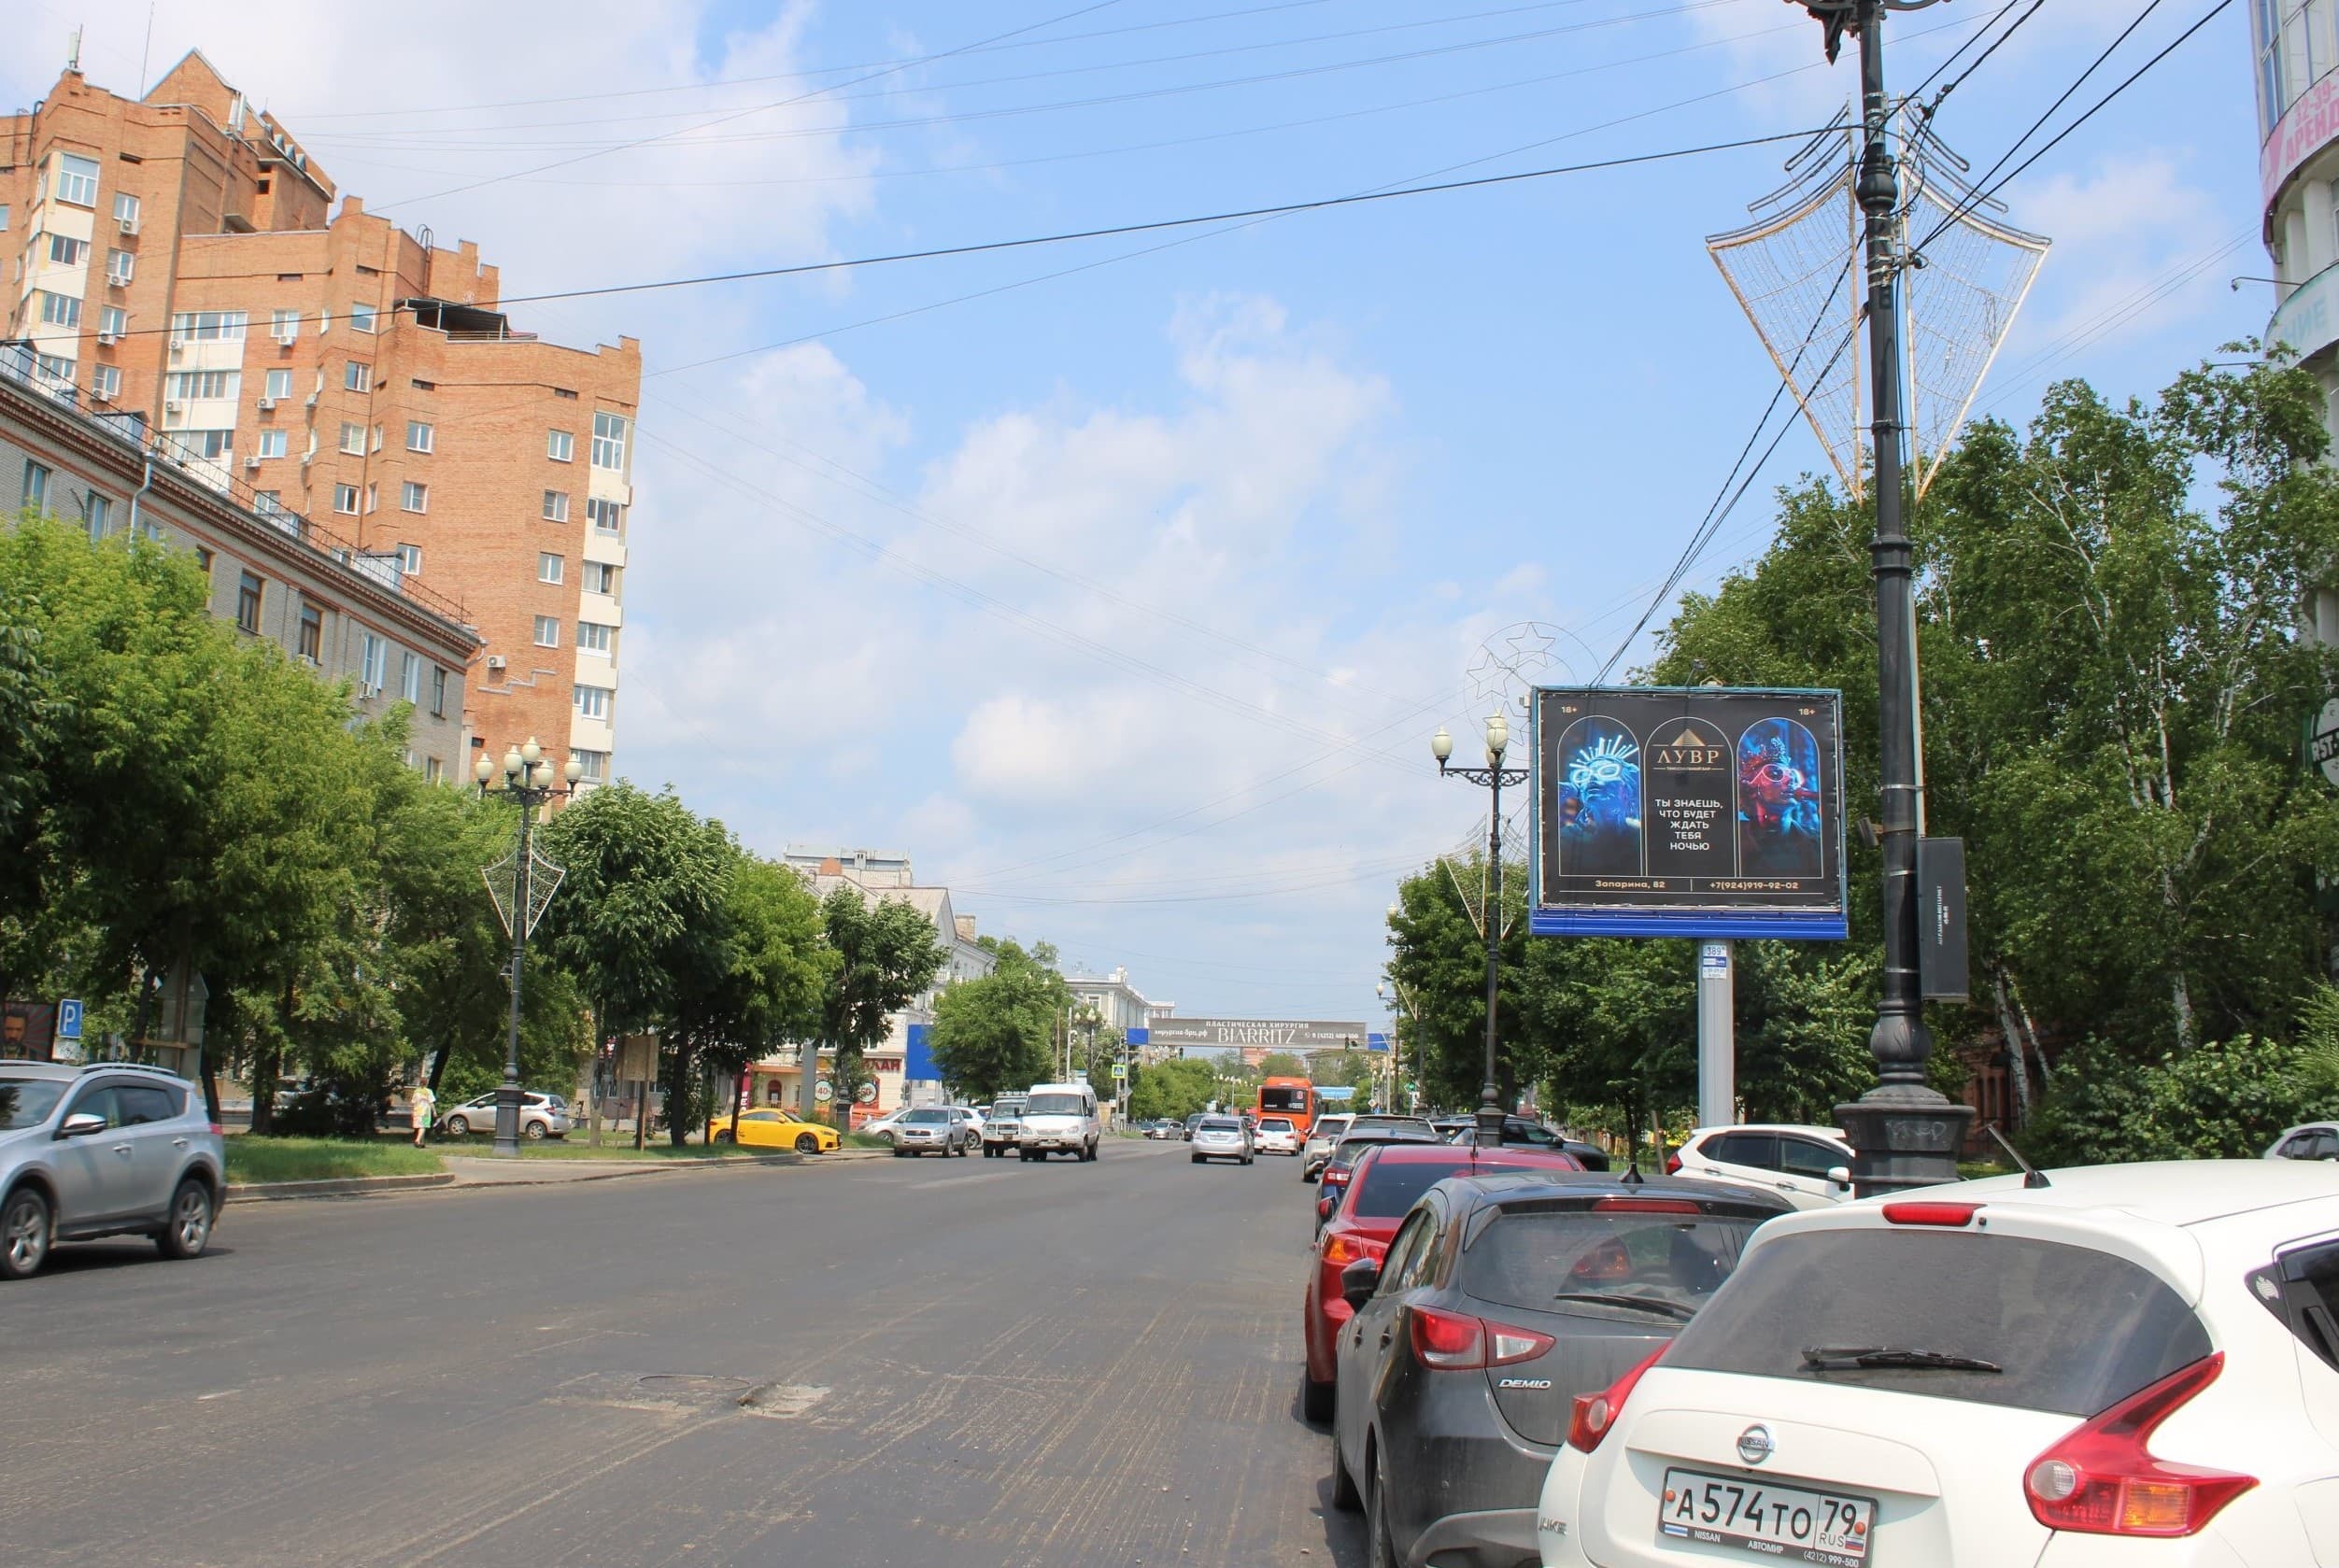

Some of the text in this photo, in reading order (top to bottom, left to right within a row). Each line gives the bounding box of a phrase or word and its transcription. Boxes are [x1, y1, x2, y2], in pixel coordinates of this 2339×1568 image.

[1657, 749, 1719, 764] ЛУВР
[1655, 798, 1723, 810] ТЫ ЗНАЕШЬ,
[1659, 810, 1716, 820] ЧТО БУДЕТ
[1670, 821, 1709, 829] ЖДАТЬ
[1675, 831, 1702, 840] ТЕБЯ
[1670, 841, 1710, 851] НОЧЬЮ
[1206, 1020, 1267, 1028] ПЛАСТИЧЕСКАЯ
[1218, 1027, 1296, 1044] BIARRITZ
[1499, 1378, 1552, 1389] DEMIO
[1824, 1500, 1857, 1535] 79
[1694, 1530, 1721, 1543] NISSAN
[1820, 1532, 1845, 1547] RUS
[1747, 1540, 1784, 1554] АВТОМИР
[1803, 1550, 1859, 1568] (4212) 999-500
